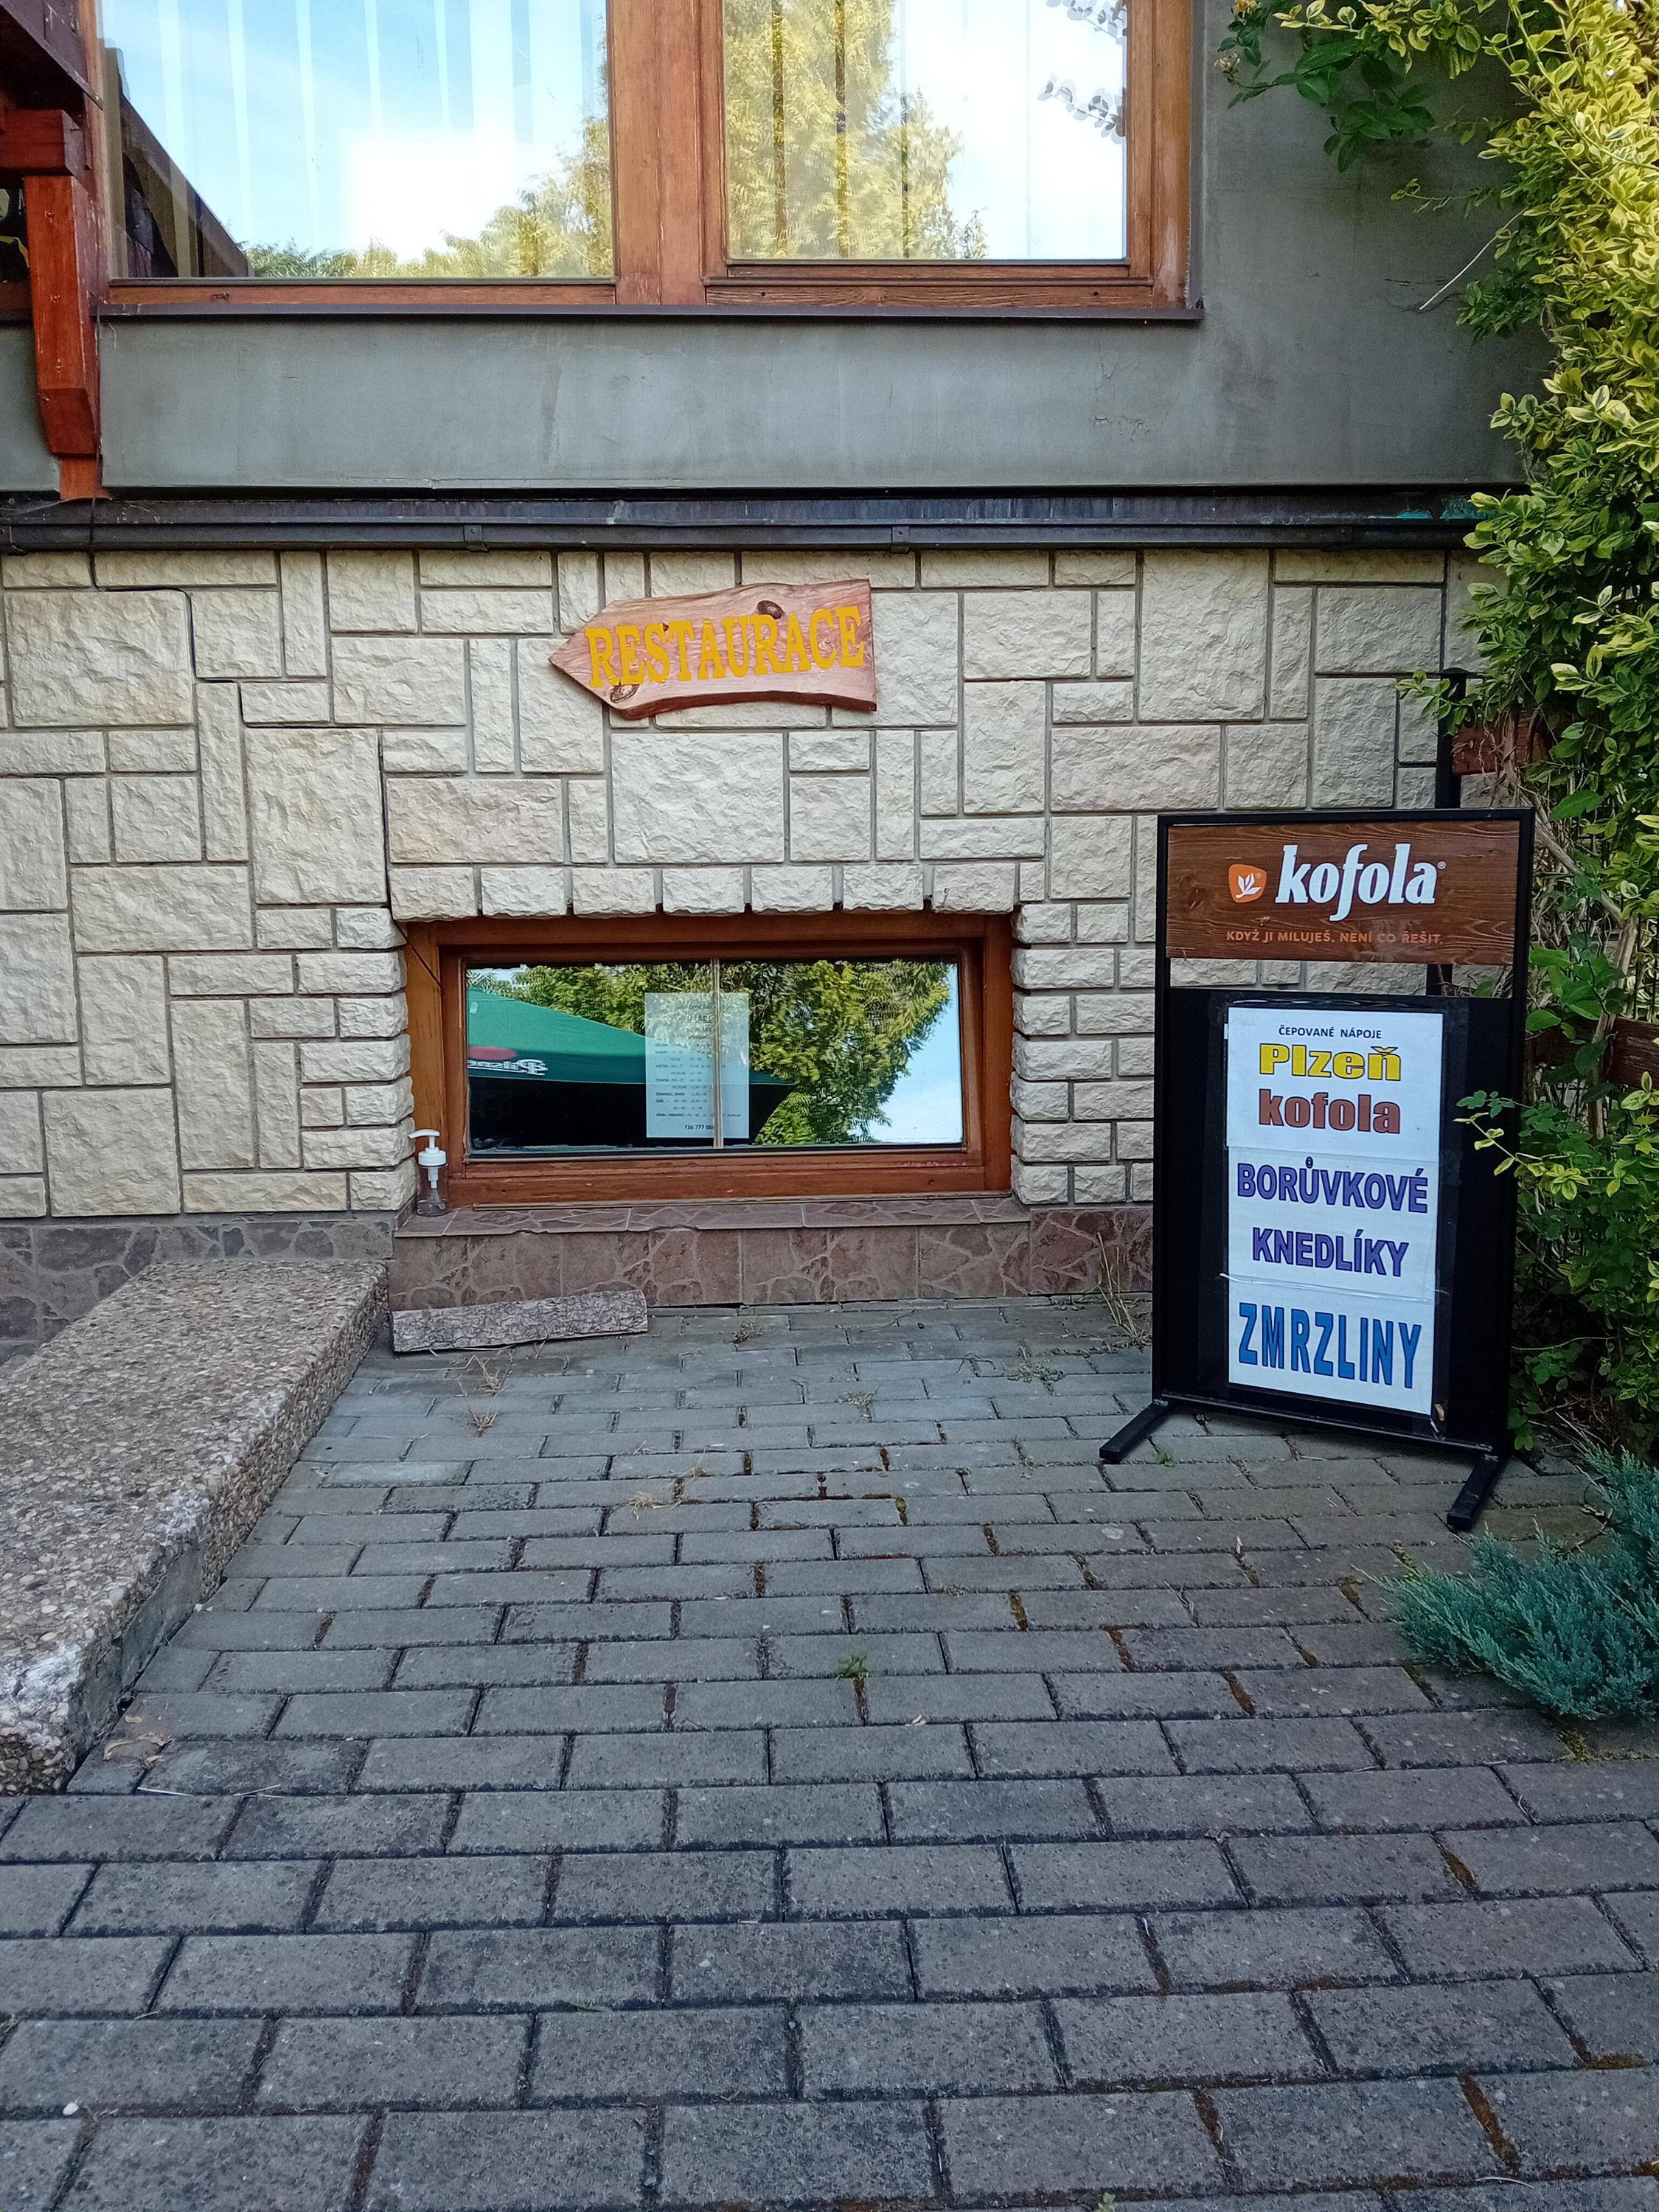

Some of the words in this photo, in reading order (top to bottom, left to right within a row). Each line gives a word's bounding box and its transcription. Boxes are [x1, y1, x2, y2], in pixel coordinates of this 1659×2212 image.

[585, 605, 865, 688] RESTAURACE
[1275, 843, 1436, 922] kofola
[1227, 929, 1259, 941] KDYŽ
[1262, 931, 1274, 943] JI
[1277, 930, 1335, 944] MILUJEŠ,
[1340, 931, 1372, 943] NENÍ
[1377, 933, 1397, 943] CO
[1401, 931, 1443, 945] ŘEŠIT.
[1279, 1024, 1335, 1037] ČEPOVANÉ
[1340, 1027, 1382, 1039] NÁPOJE
[1259, 1043, 1401, 1082] Plzeň
[1259, 1088, 1400, 1134] kofola
[1237, 1156, 1427, 1214] BORŮVKOVÉ
[1253, 1227, 1410, 1278] KNEDLÍKY
[1238, 1302, 1422, 1389] ZMRZLINY
